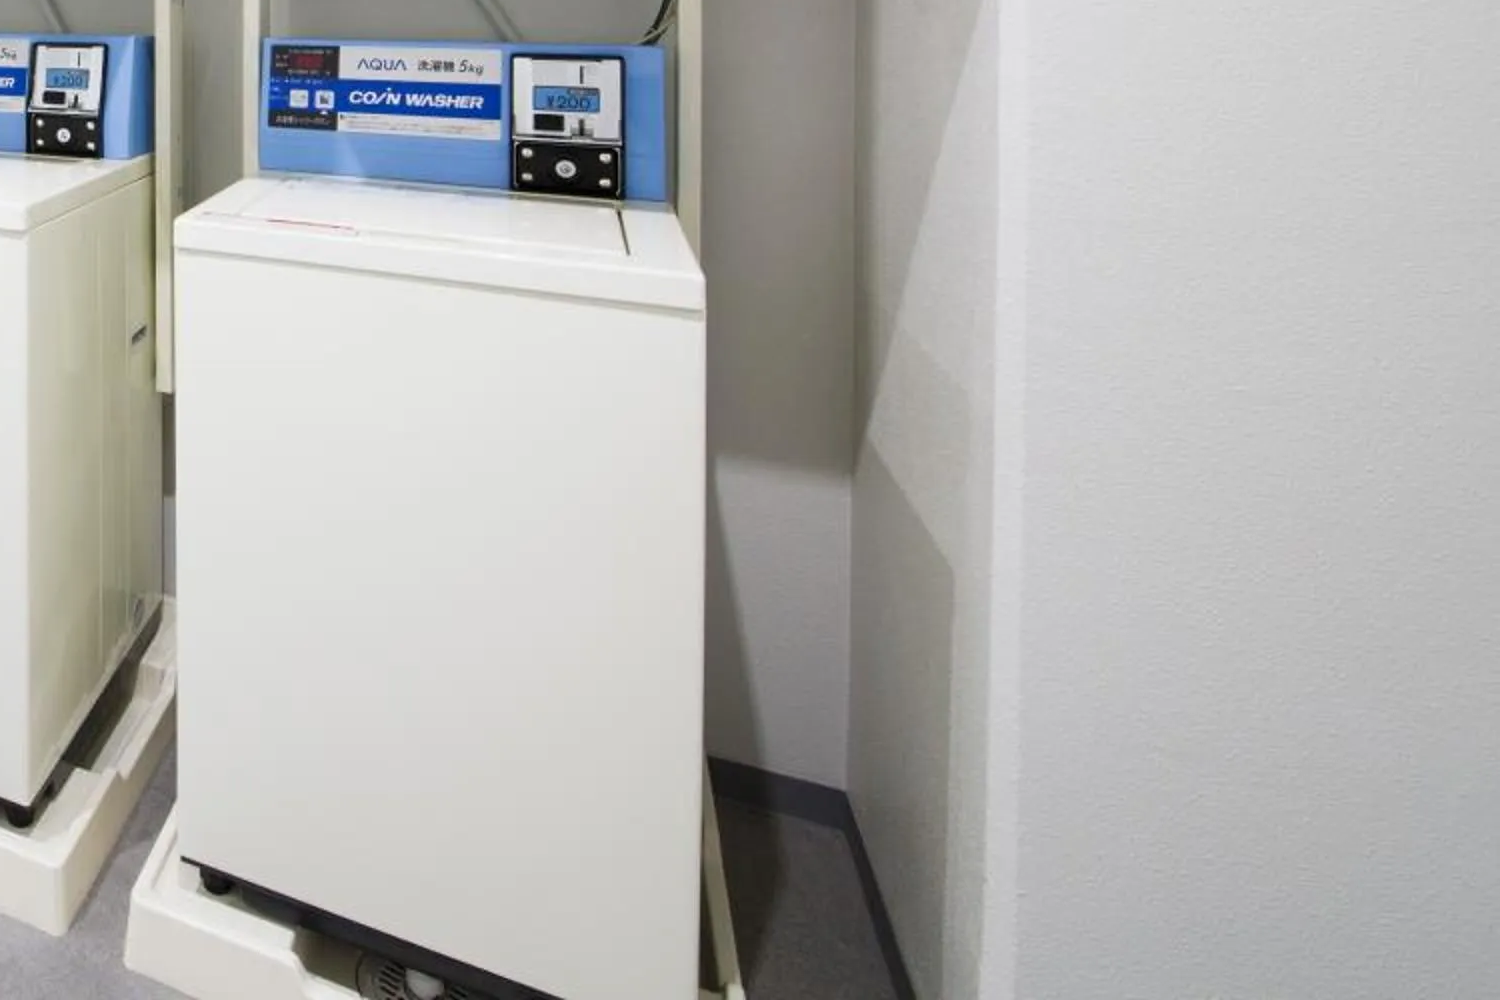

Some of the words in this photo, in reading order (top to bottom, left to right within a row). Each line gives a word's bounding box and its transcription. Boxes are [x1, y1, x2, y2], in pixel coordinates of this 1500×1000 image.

[357, 57, 407, 72] AQUA
[458, 59, 484, 76] 5kg
[405, 92, 484, 110] WASHER
